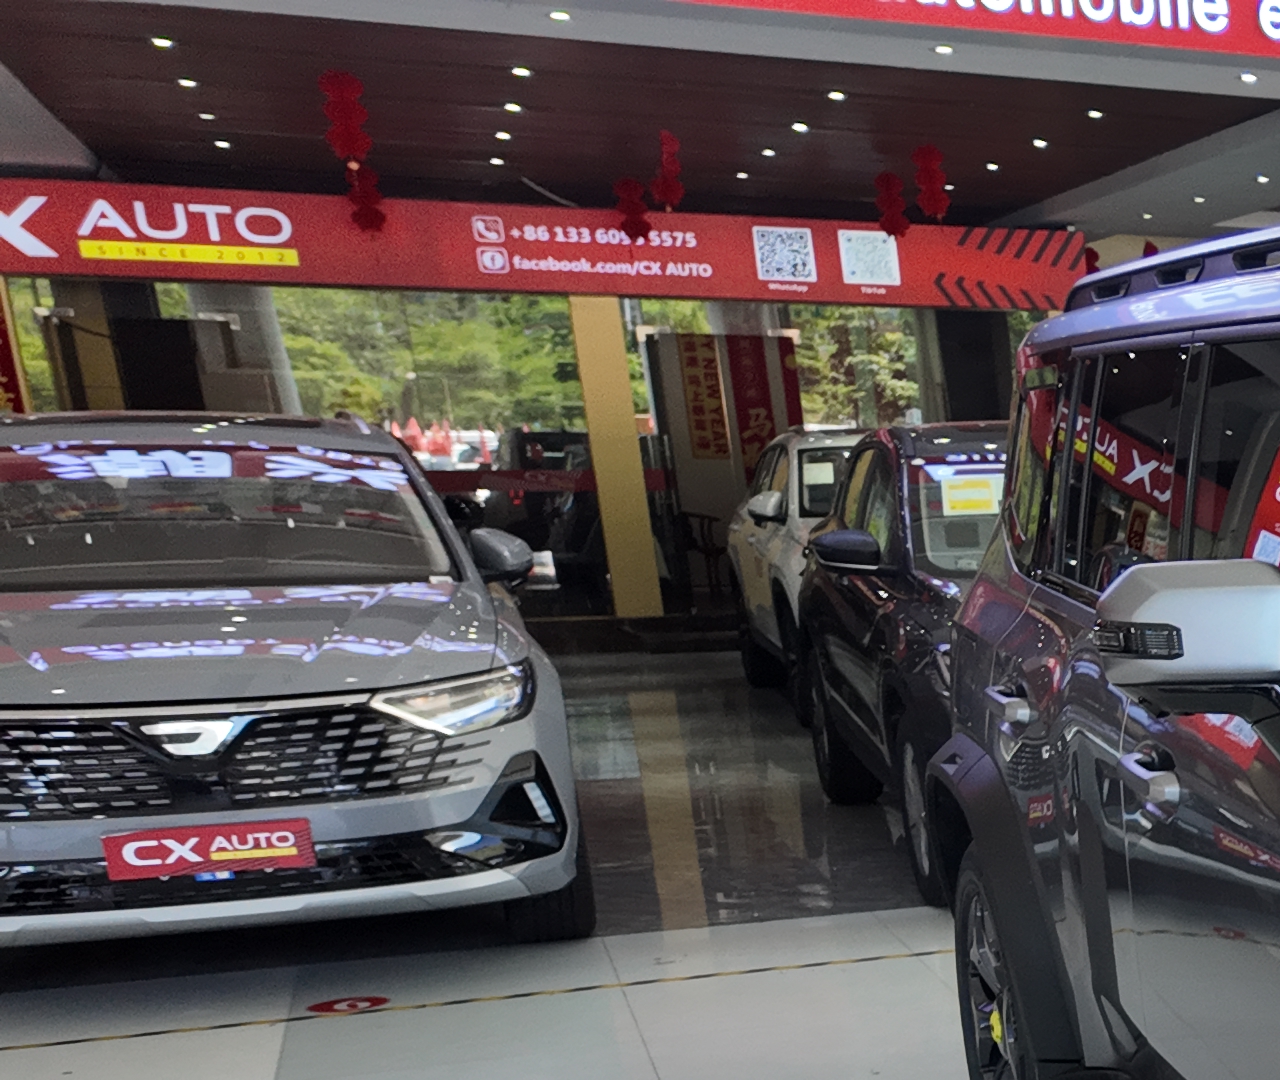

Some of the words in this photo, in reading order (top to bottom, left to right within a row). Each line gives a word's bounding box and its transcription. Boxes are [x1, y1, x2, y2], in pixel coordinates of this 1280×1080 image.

[77, 198, 293, 245] AUTO
[509, 225, 550, 242] +86
[553, 226, 592, 244] 133
[648, 230, 697, 248] 5575
[97, 246, 188, 259] SINCE
[216, 250, 286, 262] 2012
[512, 254, 663, 276] facebook.com/CX
[664, 261, 714, 278] AUTO
[121, 837, 204, 867] CX
[209, 831, 296, 852] AUTO
